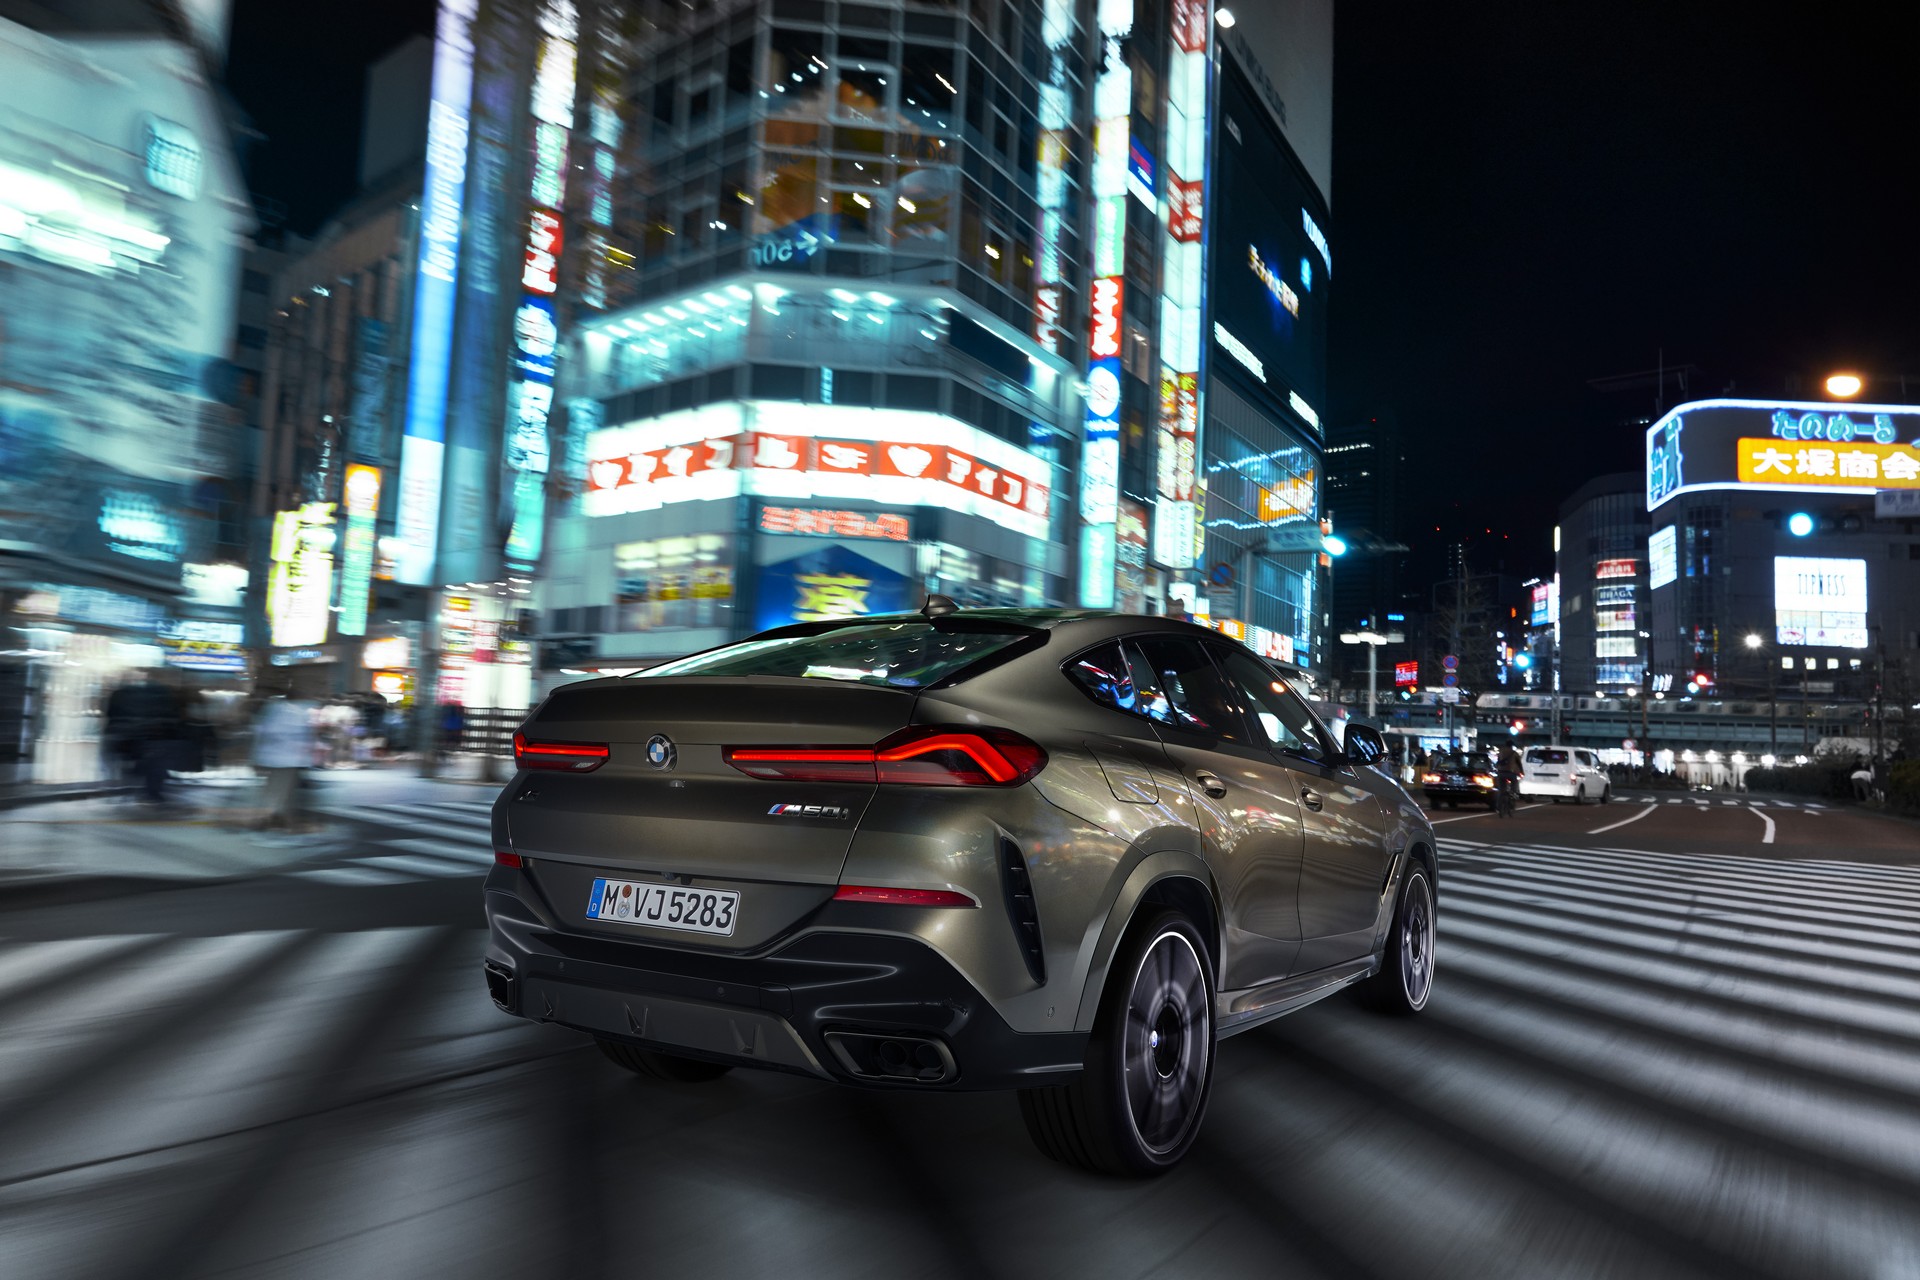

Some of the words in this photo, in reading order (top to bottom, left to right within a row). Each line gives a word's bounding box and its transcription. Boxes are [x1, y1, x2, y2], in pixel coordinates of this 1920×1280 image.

[1772, 410, 1897, 444] たのめーる
[627, 435, 799, 484] アイフル
[1752, 447, 1920, 480] 大塚商会
[591, 902, 597, 912] D
[601, 884, 620, 915] M
[634, 887, 666, 921] VJ
[668, 891, 736, 929] 5283
